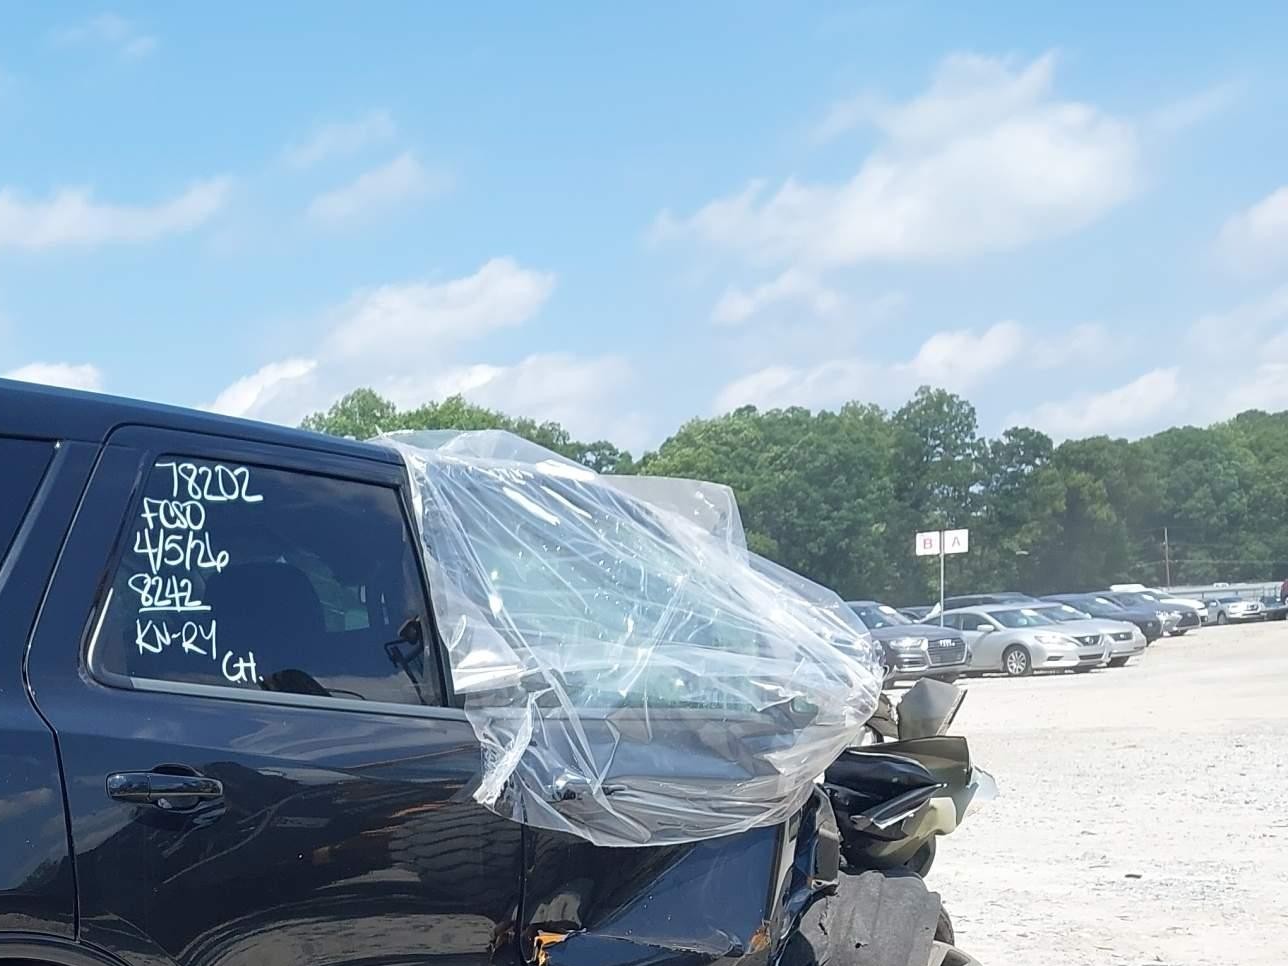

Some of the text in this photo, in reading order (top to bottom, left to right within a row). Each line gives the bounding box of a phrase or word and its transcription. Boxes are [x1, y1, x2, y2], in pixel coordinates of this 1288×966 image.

[154, 462, 264, 502] 78202
[133, 528, 230, 575] 4/5/26
[923, 538, 933, 549] B
[128, 573, 202, 612] 8242
